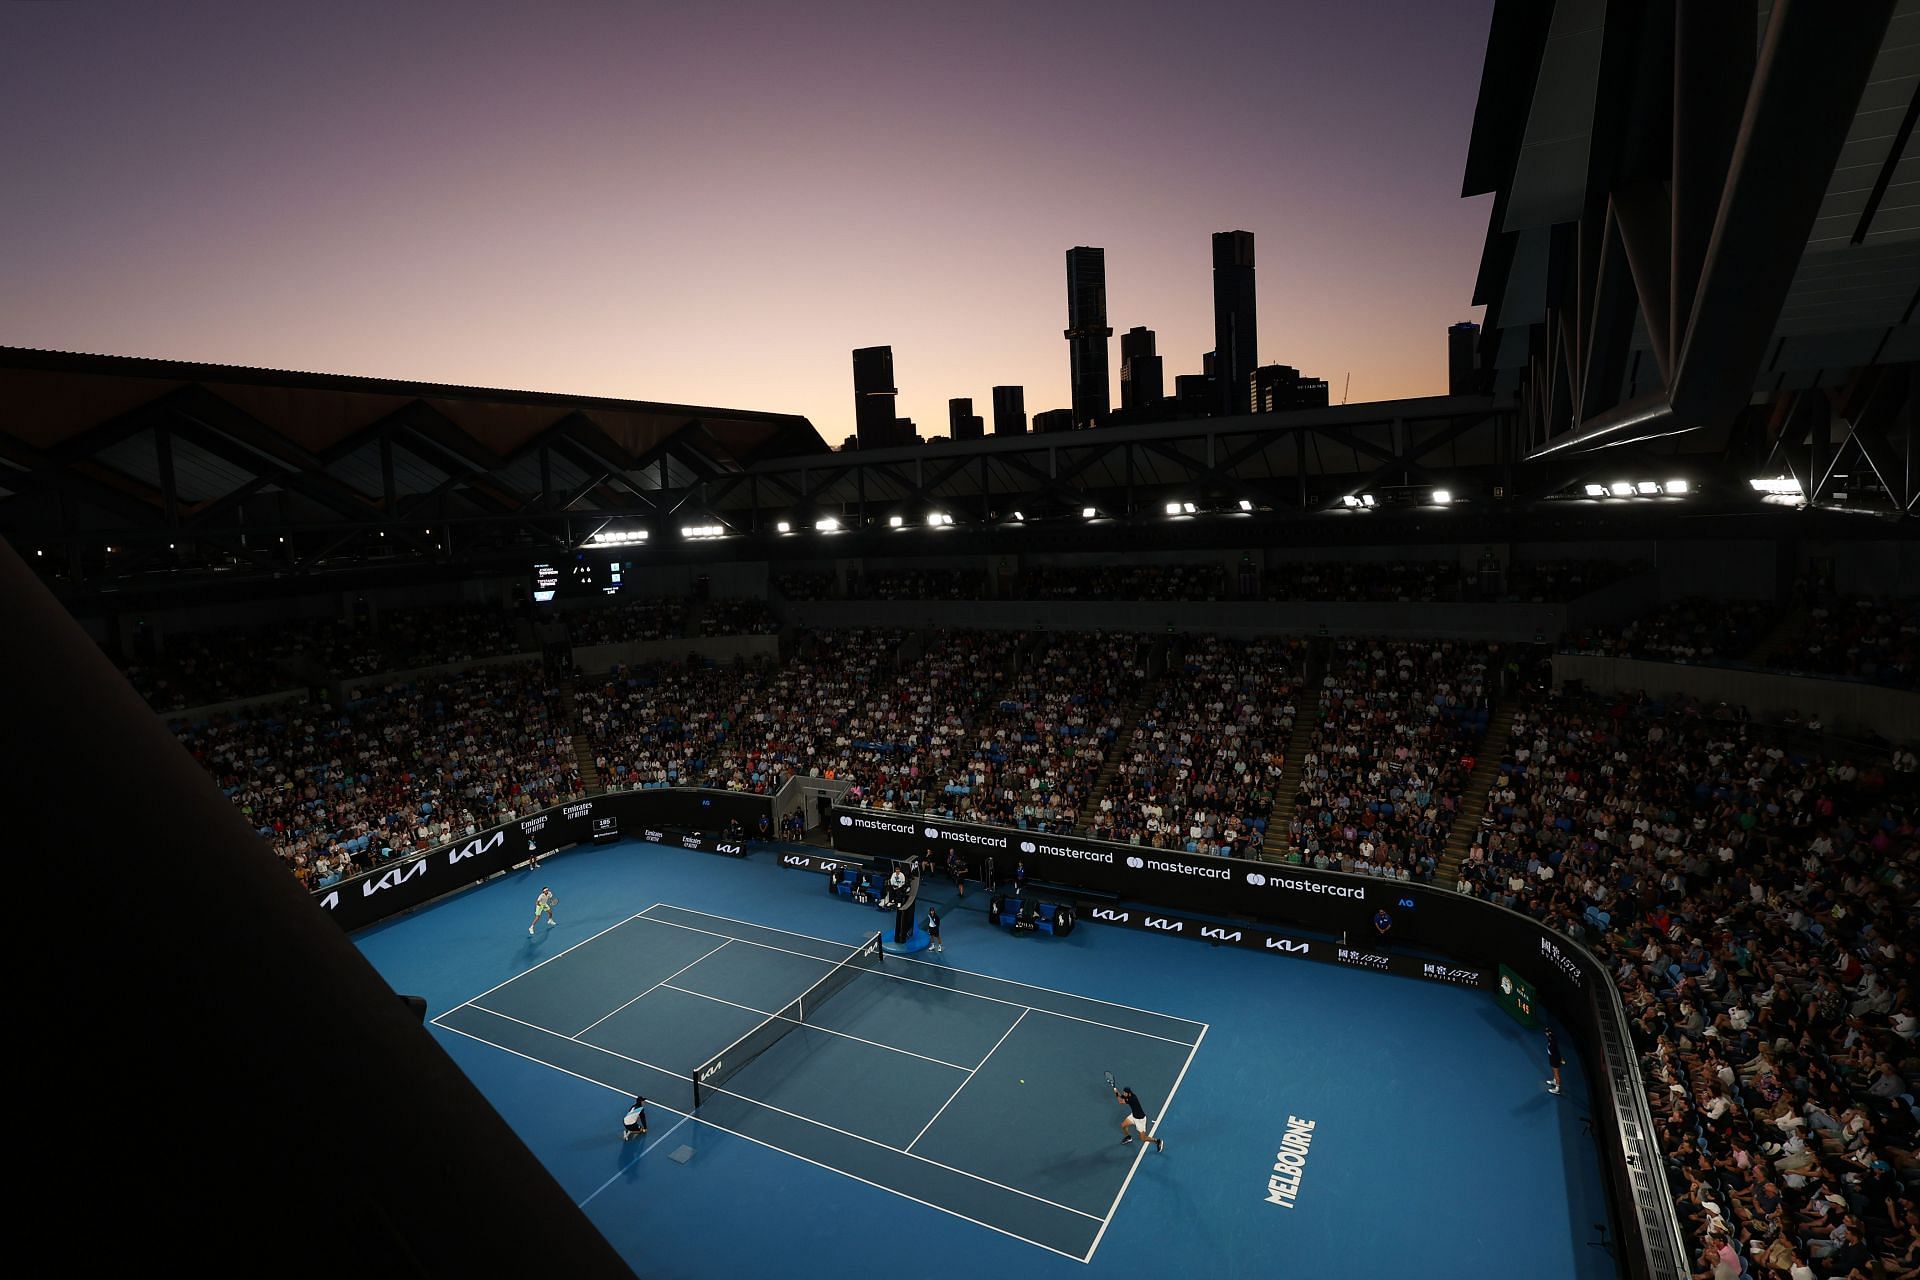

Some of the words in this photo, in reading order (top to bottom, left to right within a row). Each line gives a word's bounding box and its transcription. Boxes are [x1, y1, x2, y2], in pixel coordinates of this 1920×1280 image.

[563, 802, 593, 815] Emirates
[521, 815, 548, 830] Emirates
[854, 818, 915, 834] mastercard
[448, 830, 504, 865] KIA
[941, 830, 1007, 848] mastercard
[716, 843, 740, 854] KIA
[1038, 844, 1113, 864] mastercard
[783, 855, 810, 866] KIA
[362, 858, 427, 897] KIA
[1147, 859, 1231, 880] mastercard
[1269, 876, 1365, 900] mastercard
[1092, 908, 1129, 923] KIA
[1144, 916, 1183, 932] KIA
[1201, 926, 1242, 942] KIA
[1266, 937, 1309, 954] KIA
[700, 1060, 722, 1081] KIA
[1263, 1114, 1316, 1209] MELBOURNE
